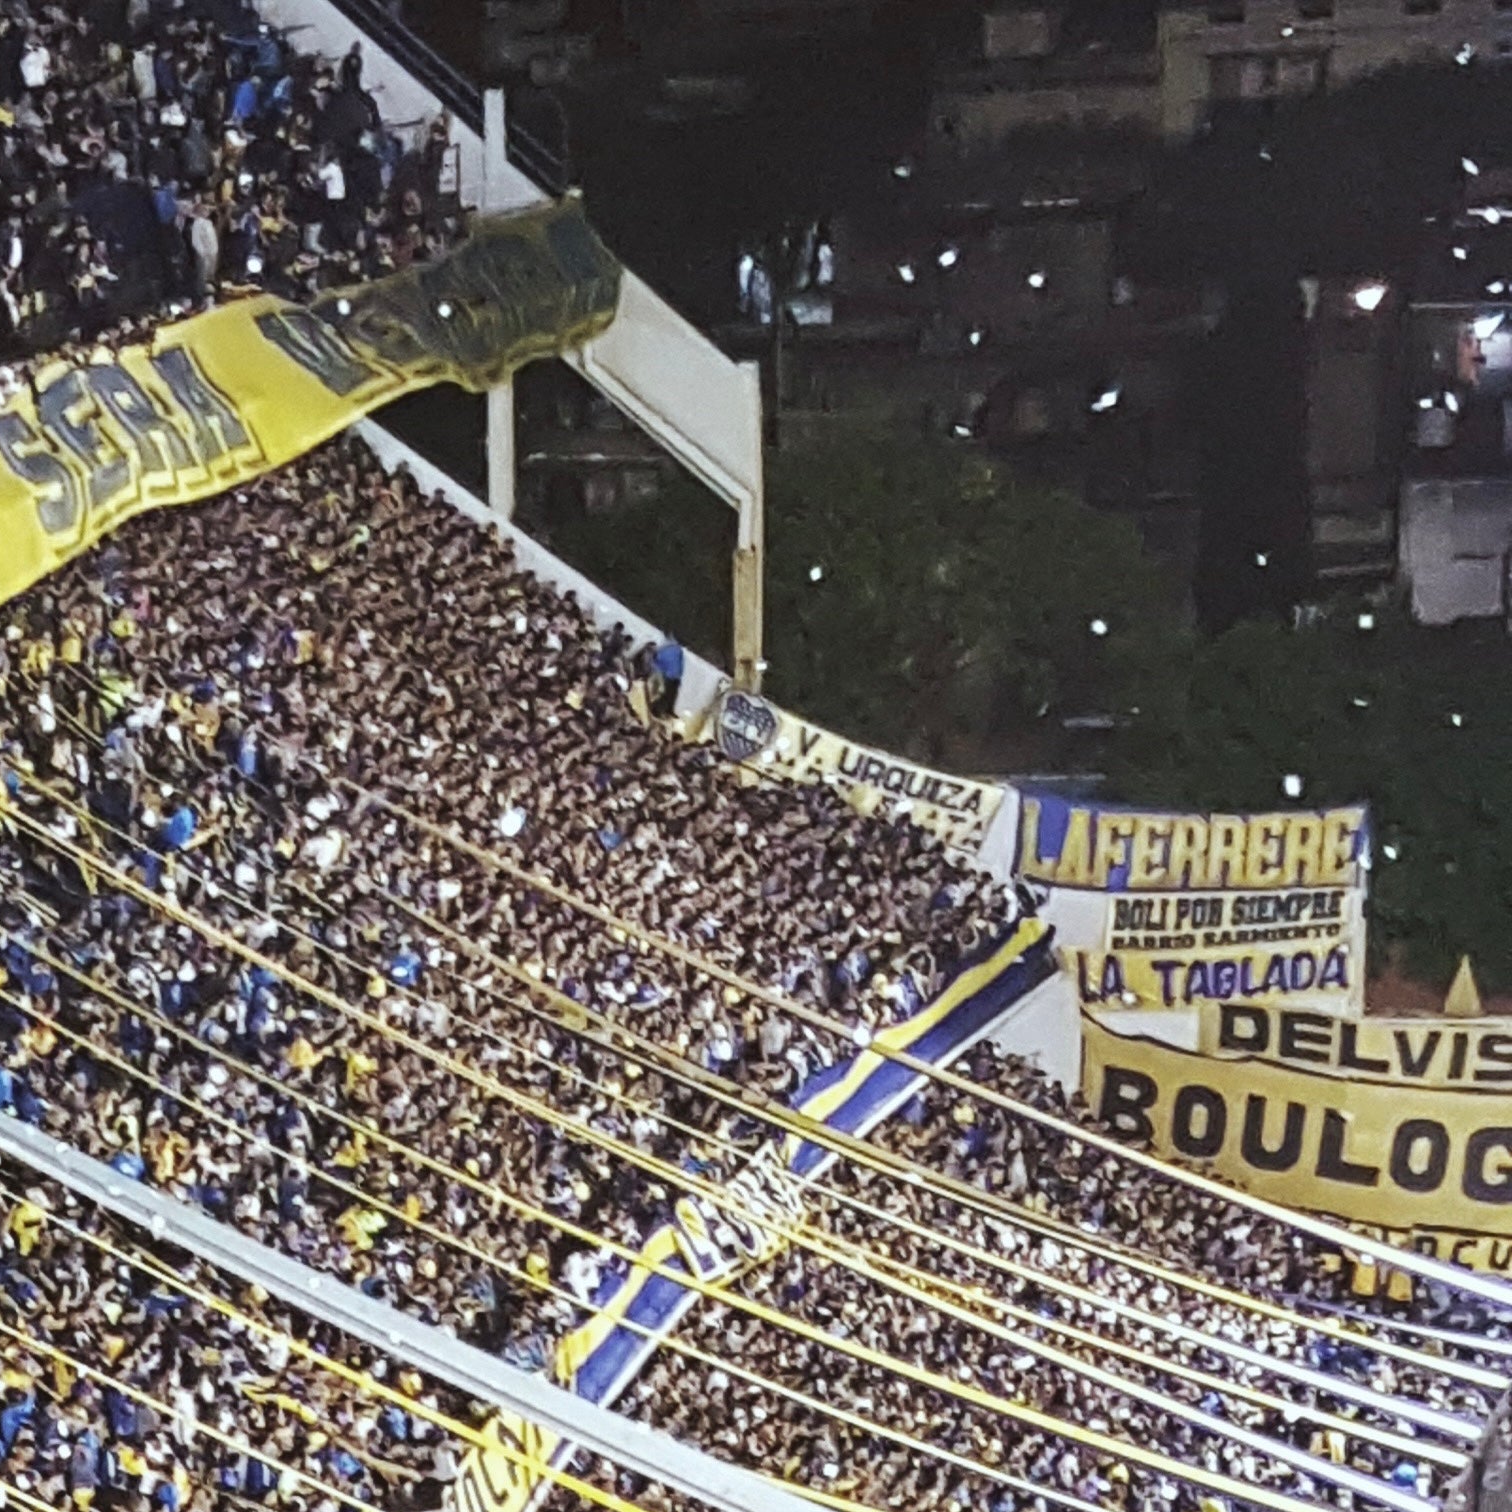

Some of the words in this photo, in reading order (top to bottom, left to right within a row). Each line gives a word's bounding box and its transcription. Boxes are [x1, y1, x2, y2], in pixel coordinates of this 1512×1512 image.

[838, 745, 985, 816] URQUIZA
[1020, 797, 1365, 889] LAFERRERE
[1174, 896, 1224, 931] POR
[1230, 889, 1346, 926] SIEMPRE
[1077, 952, 1126, 1003] LA
[1151, 944, 1349, 1006] TABLADA
